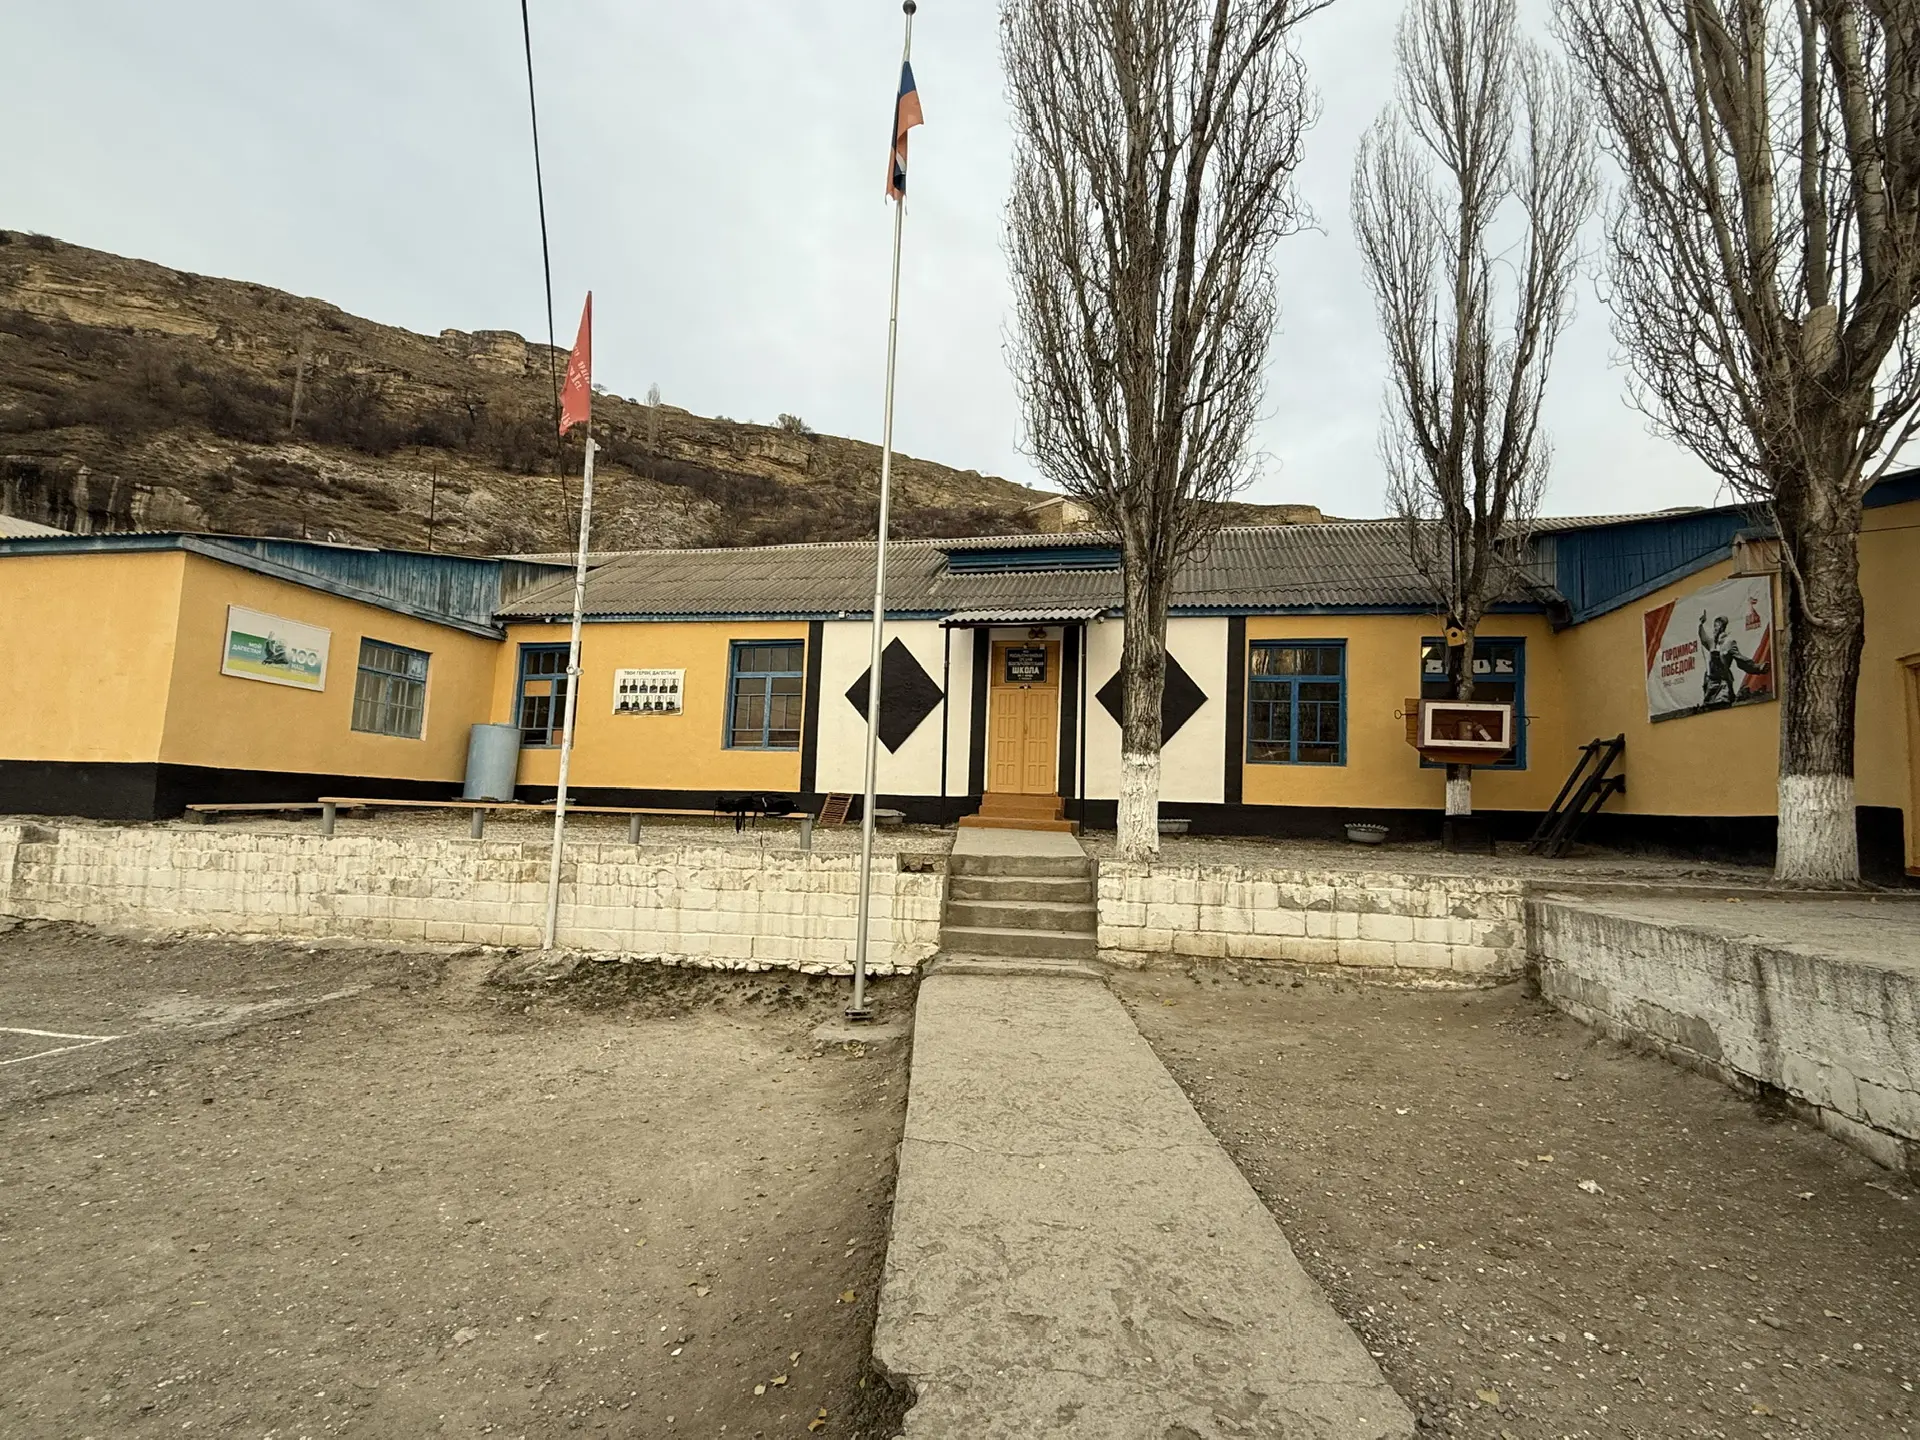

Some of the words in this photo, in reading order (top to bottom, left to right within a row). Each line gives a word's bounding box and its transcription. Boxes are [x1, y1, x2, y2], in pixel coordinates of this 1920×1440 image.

[231, 643, 262, 655] ДАГЕСТАН
[248, 641, 262, 649] МОЙ
[1661, 640, 1698, 662] ГОРДИМСЯ
[291, 647, 317, 667] 100
[1012, 666, 1040, 675] ШКОЛА
[1661, 656, 1695, 678] ПОБЕДОЙ!
